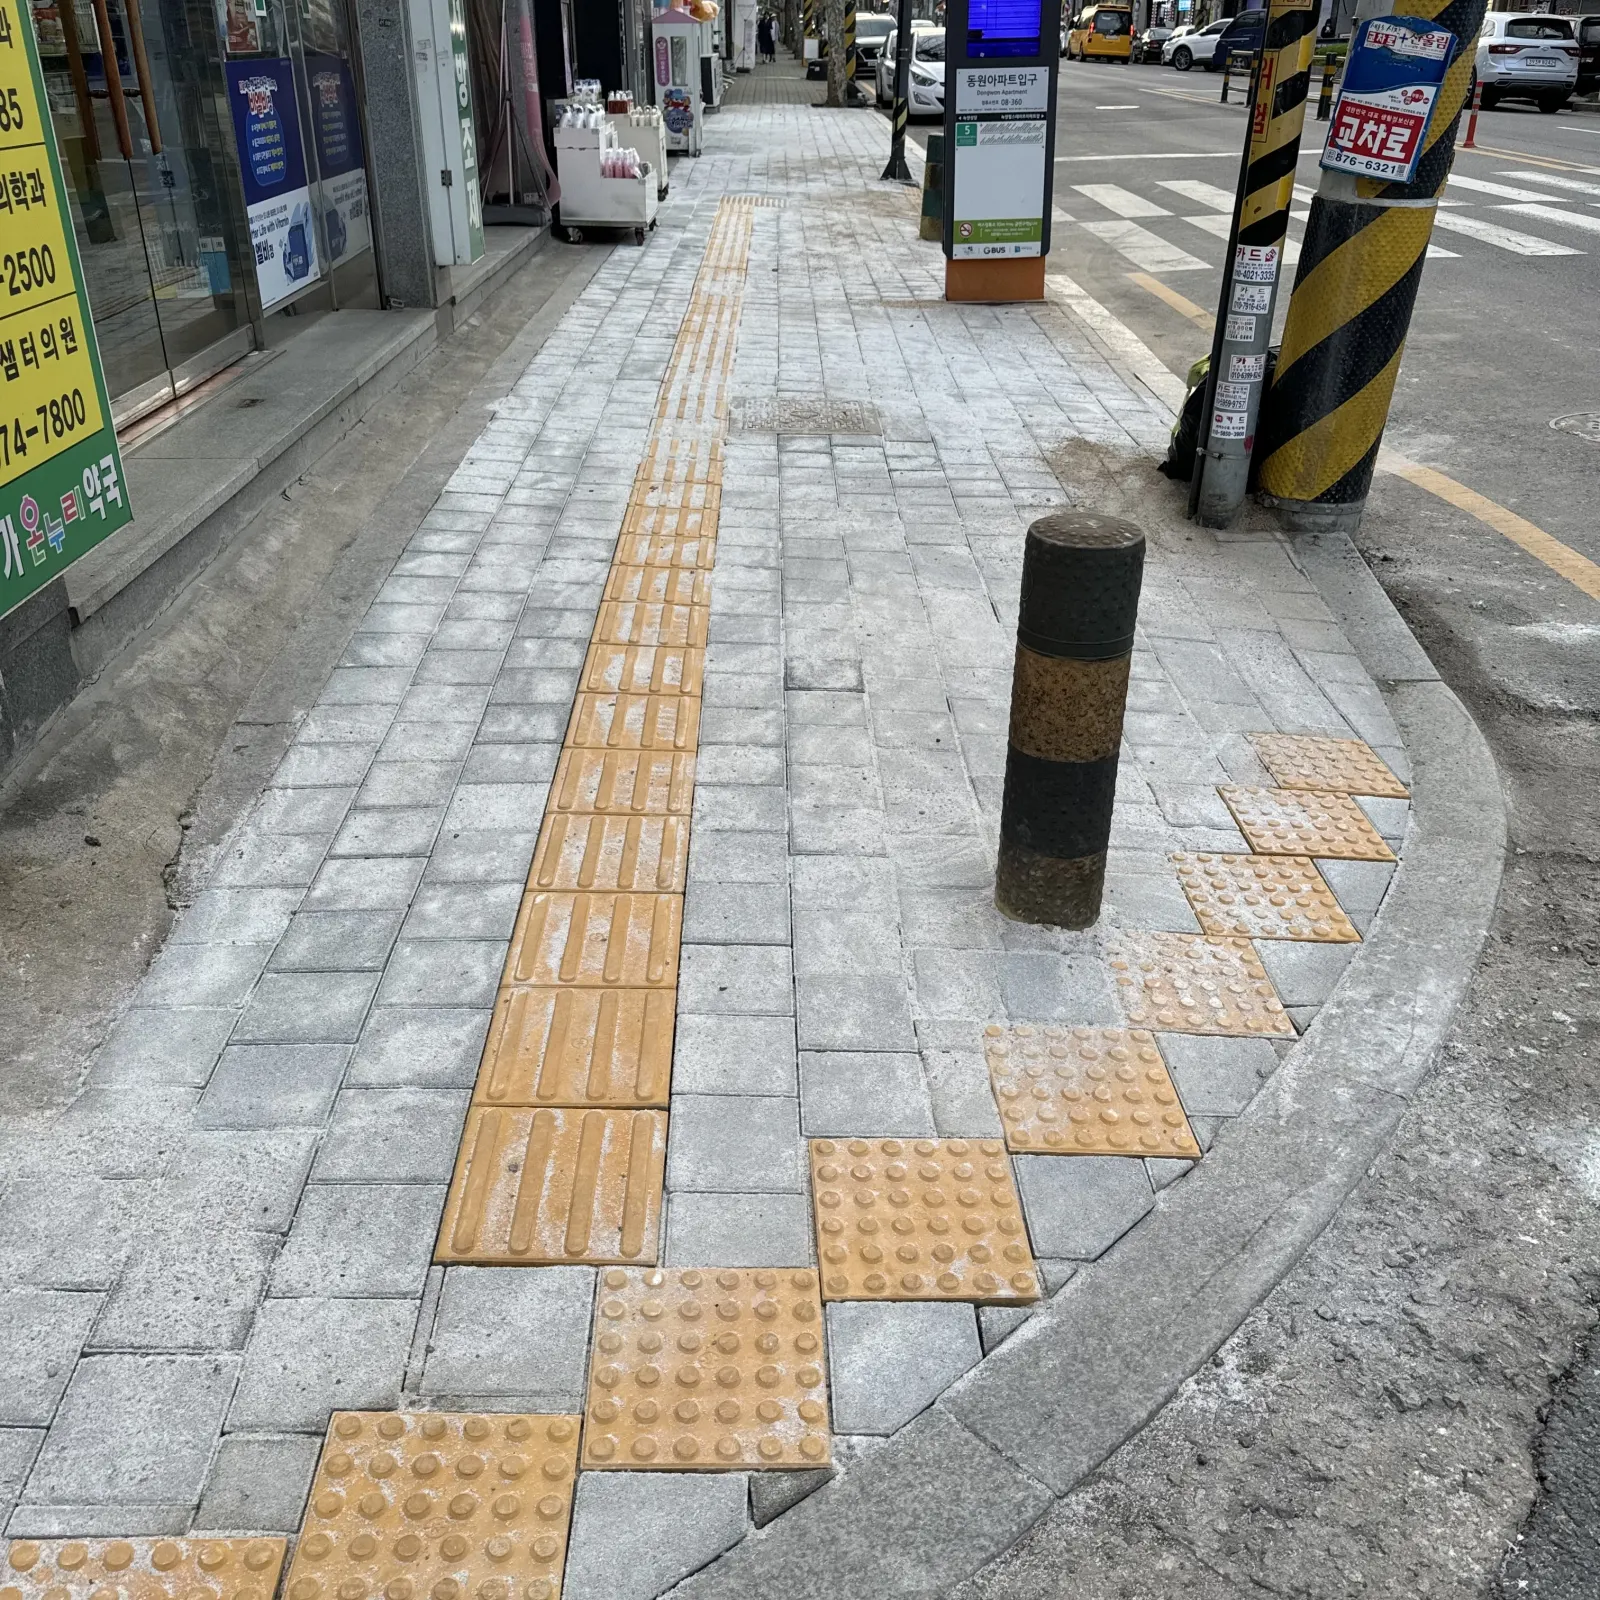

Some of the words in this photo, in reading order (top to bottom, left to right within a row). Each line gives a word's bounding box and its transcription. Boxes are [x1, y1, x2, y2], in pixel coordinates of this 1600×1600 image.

[1367, 31, 1397, 47] 교차로
[966, 73, 1038, 89] 동원아파트입구
[1000, 98, 1022, 106] 08-360
[1345, 106, 1365, 117] 대한민국
[1367, 111, 1379, 121] 대표
[964, 125, 971, 135] 5
[1335, 115, 1412, 160] 교차로
[1335, 152, 1397, 174] 876-6321
[0, 168, 46, 214] 의학과
